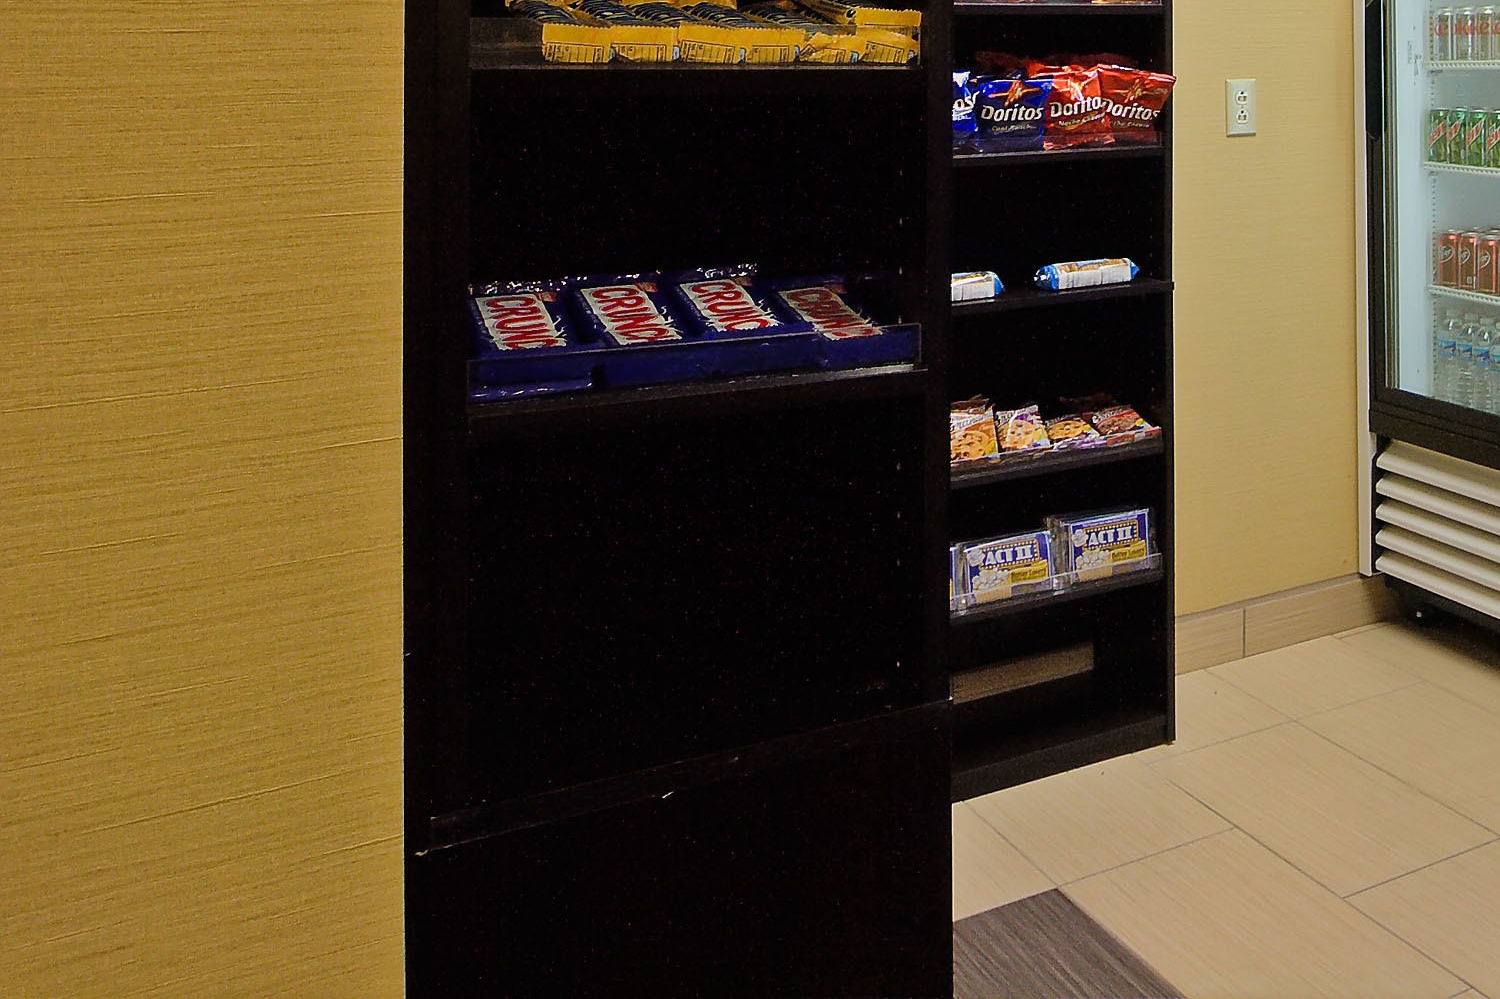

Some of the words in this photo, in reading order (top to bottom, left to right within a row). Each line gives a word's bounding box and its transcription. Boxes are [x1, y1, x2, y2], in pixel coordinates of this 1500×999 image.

[980, 103, 1045, 122] Doritos
[1049, 97, 1101, 118] Dorito
[591, 286, 674, 341] CRUNC
[690, 281, 771, 332] CRUNC
[486, 295, 559, 349] CRUNC
[1088, 529, 1116, 547] ACT
[1116, 526, 1133, 541] II
[985, 547, 1013, 566] ACT
[1015, 544, 1033, 561] II
